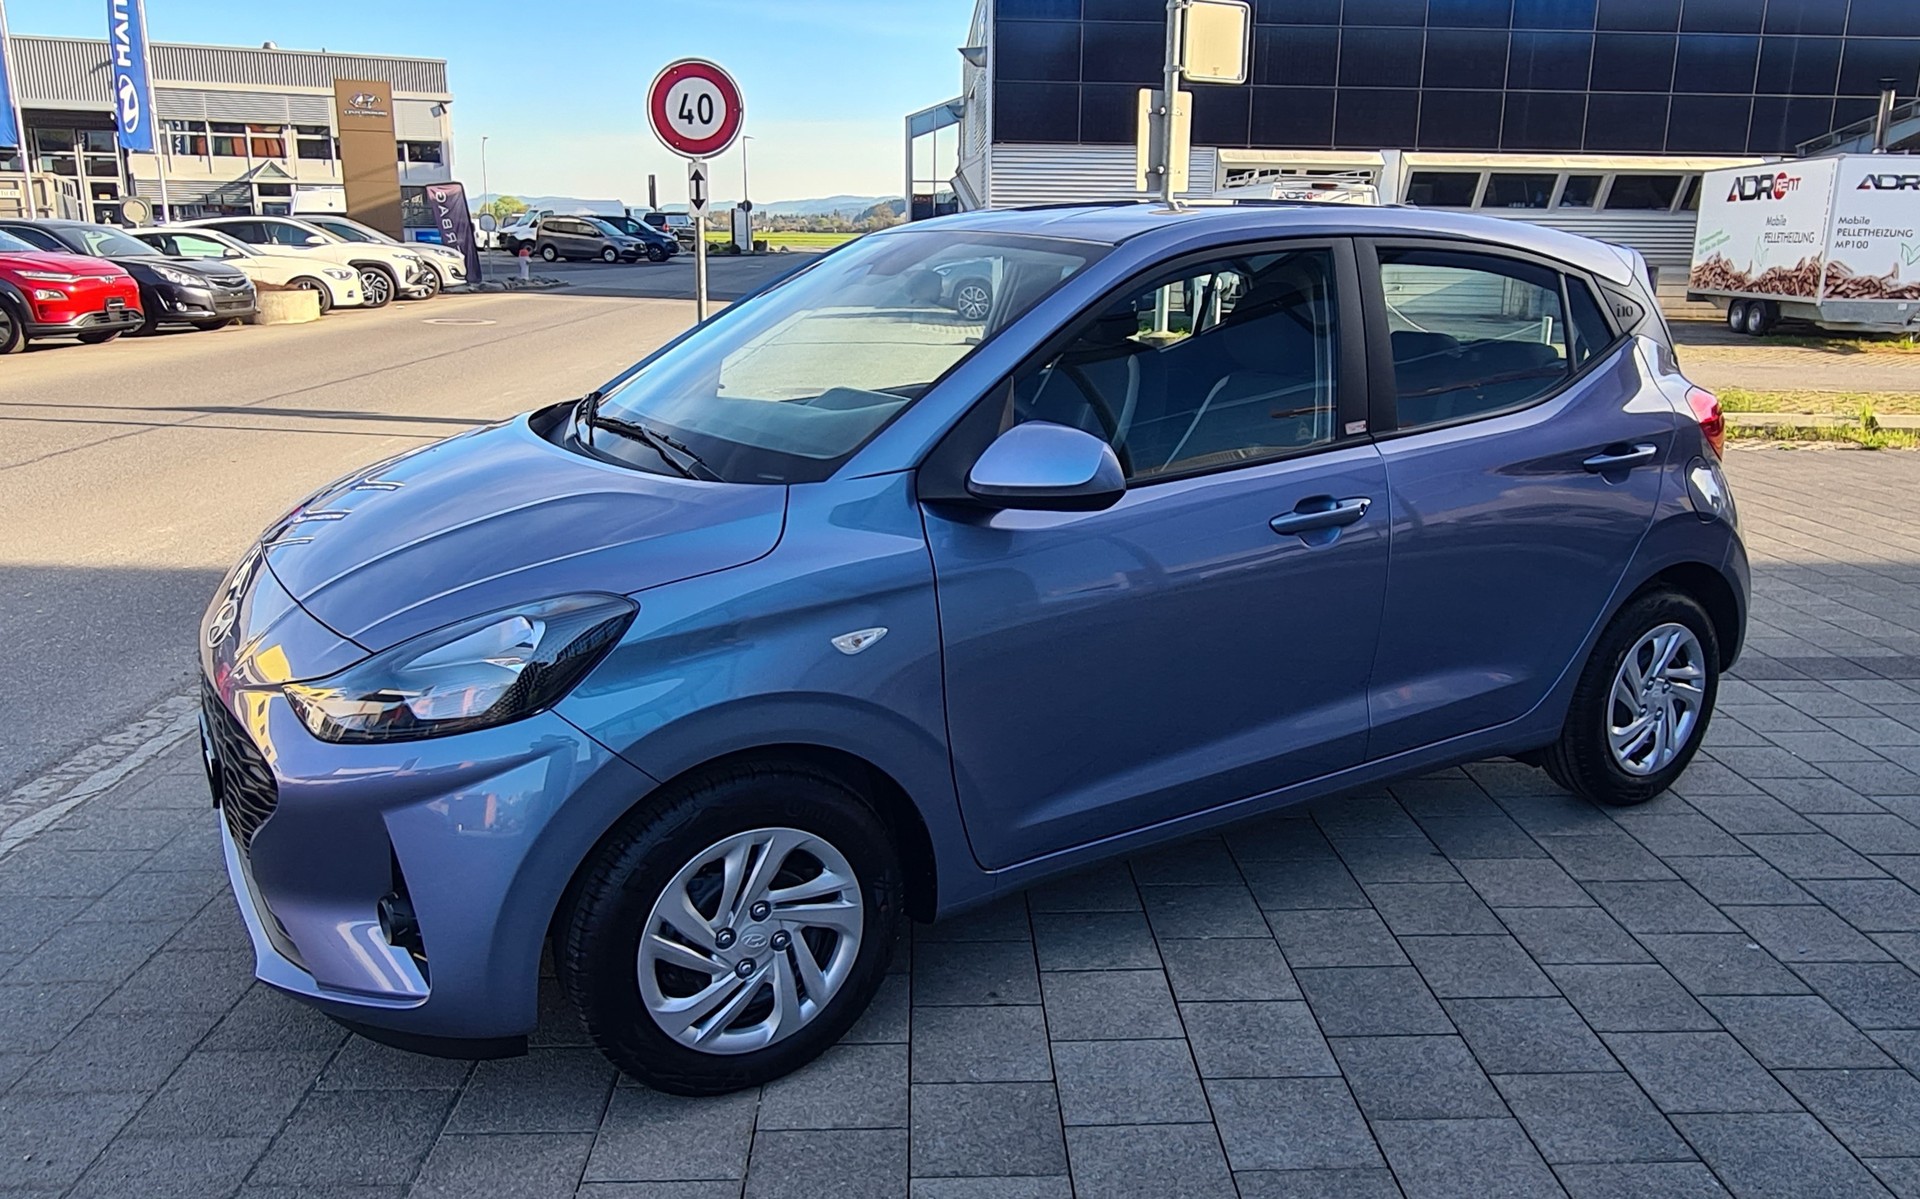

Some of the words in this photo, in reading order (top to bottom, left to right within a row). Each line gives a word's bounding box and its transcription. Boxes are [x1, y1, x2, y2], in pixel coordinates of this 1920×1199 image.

[678, 93, 713, 126] 40
[1765, 214, 1787, 226] Mobile
[1838, 216, 1871, 226] Mobile
[1764, 231, 1815, 244] PELLETHEIZUNG
[1836, 228, 1914, 238] PELLETHEIZUNG
[1834, 240, 1869, 249] MP100
[1616, 303, 1634, 318] i10
